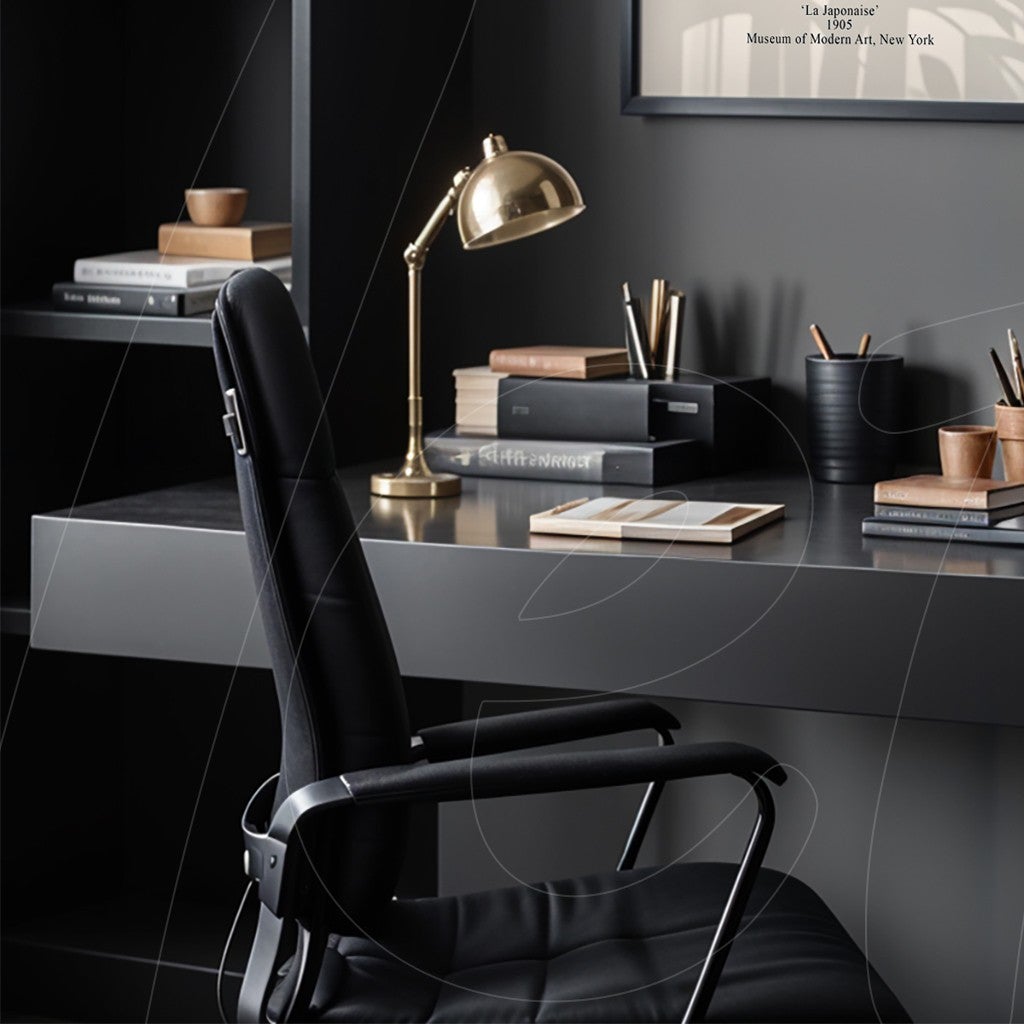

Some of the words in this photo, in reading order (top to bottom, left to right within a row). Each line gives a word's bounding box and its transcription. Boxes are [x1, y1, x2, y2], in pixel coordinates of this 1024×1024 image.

[827, 19, 853, 31] 1905
[747, 32, 792, 44] Museum
[795, 32, 808, 44] of
[810, 33, 852, 45] Modern
[854, 34, 876, 46] Art,
[879, 33, 905, 45] New
[908, 34, 934, 45] York
